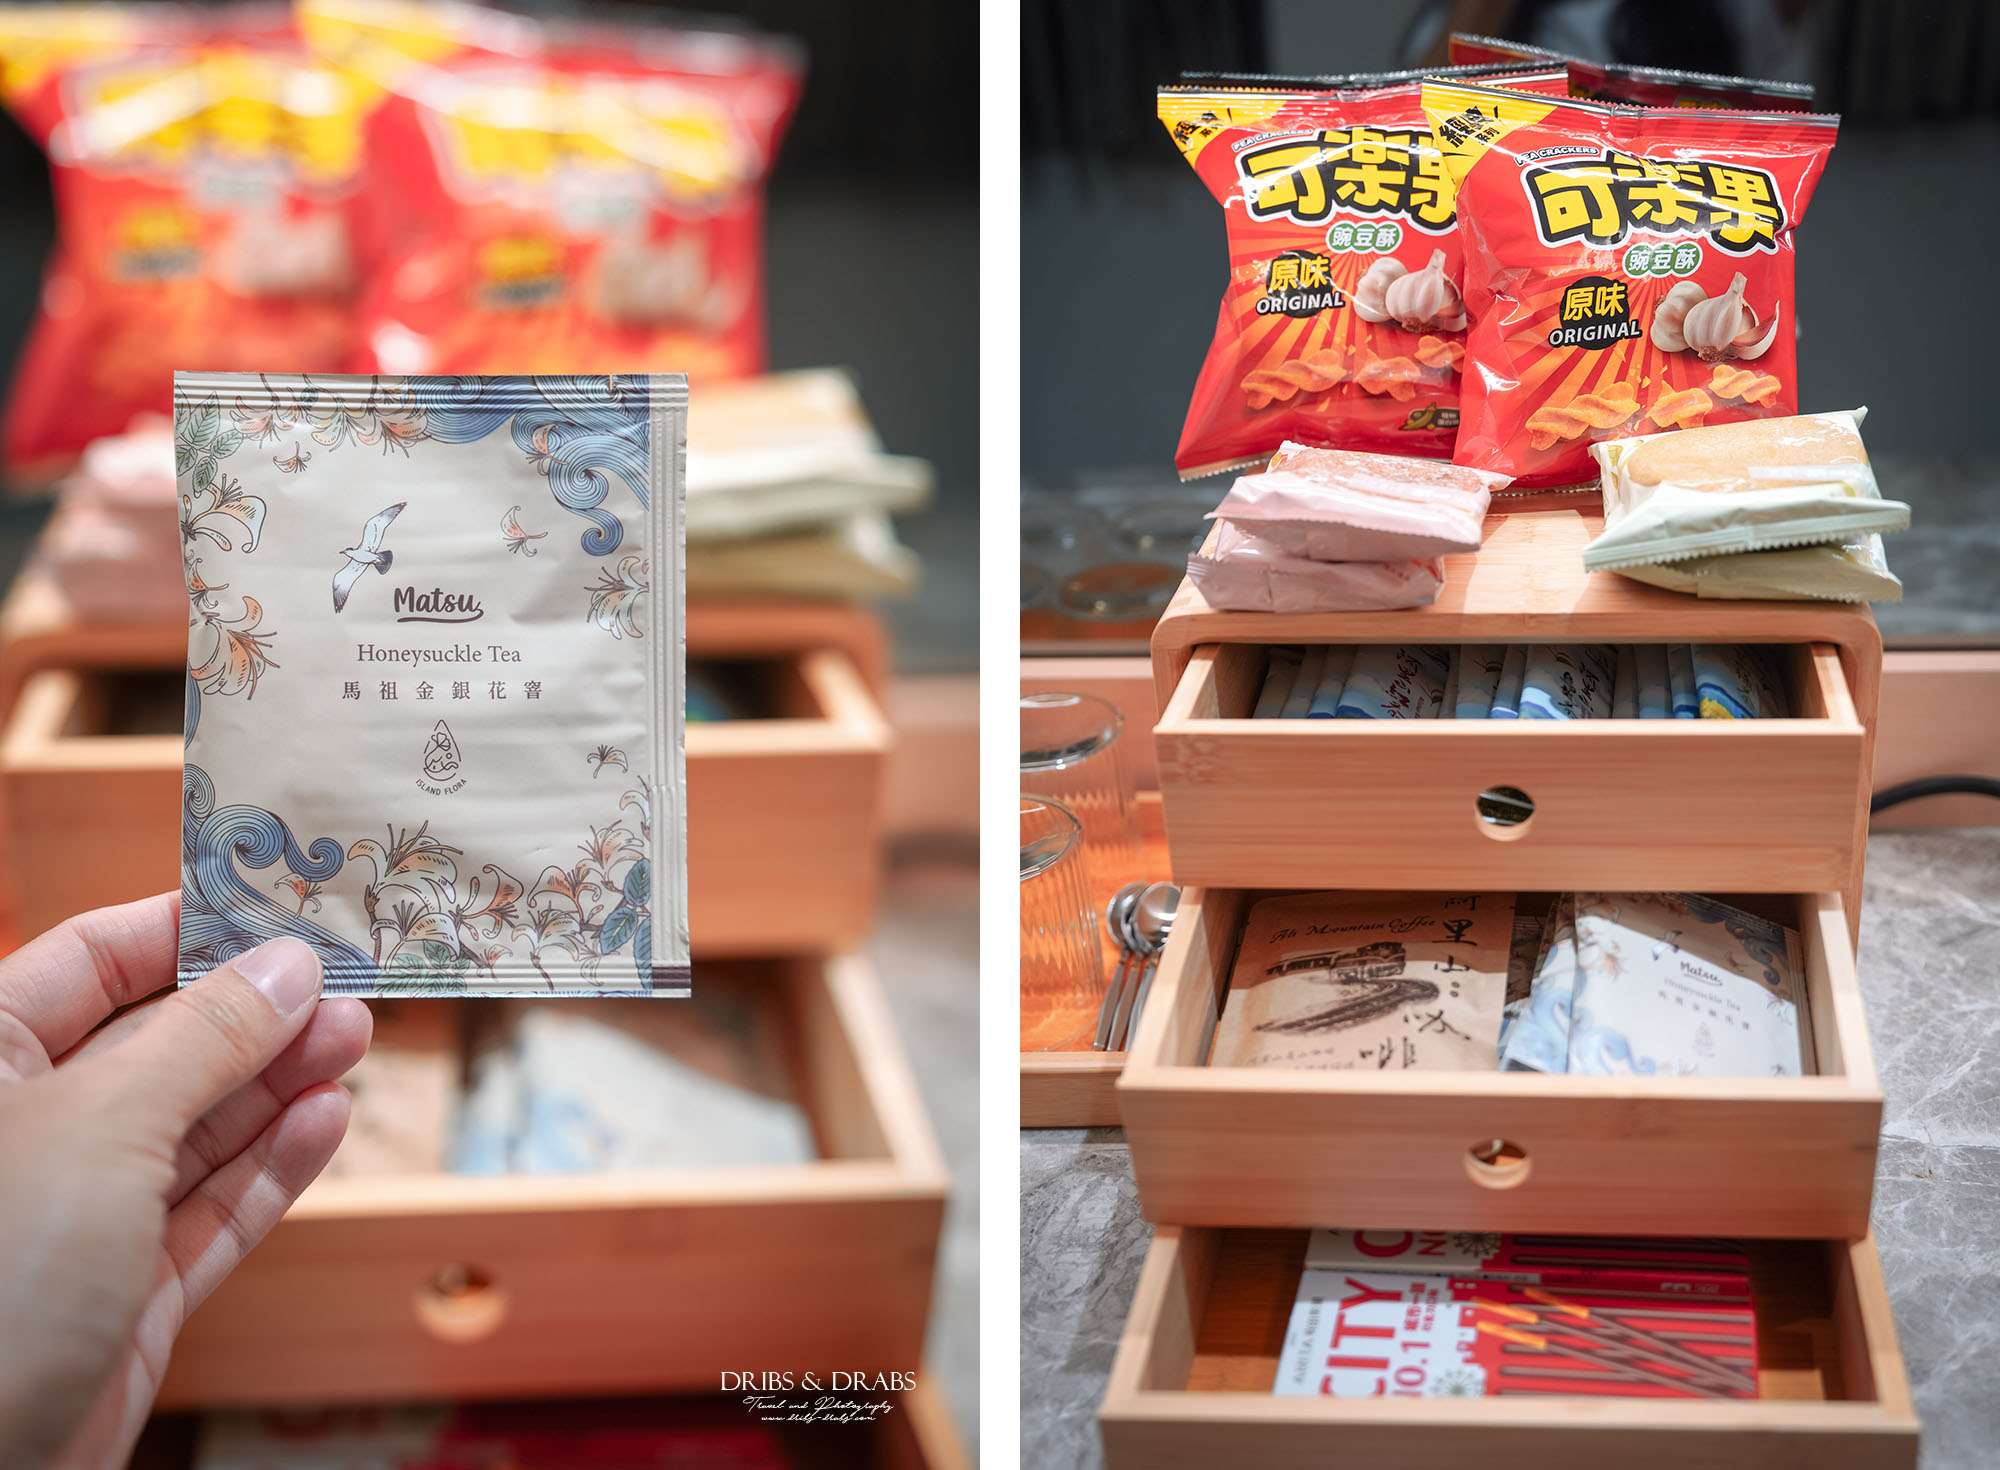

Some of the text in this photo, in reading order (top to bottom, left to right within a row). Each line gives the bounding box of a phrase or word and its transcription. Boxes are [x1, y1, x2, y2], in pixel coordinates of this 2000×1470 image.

[1540, 146, 1598, 159] CRACKERS
[1331, 226, 1397, 248] 豌豆酥
[1627, 247, 1697, 273] 豌豆酥
[1269, 255, 1330, 291] 原味
[1258, 292, 1344, 315] ORIGINAL
[1562, 282, 1626, 321] 原味
[1549, 320, 1640, 346] ORIGINAL
[393, 586, 485, 624] Matsu
[357, 643, 522, 668] Honeysuckle Tea
[415, 777, 468, 797] ISLAND FLORA
[1305, 921, 1385, 937] Mountain
[1388, 914, 1437, 935] Coffee
[1679, 961, 1724, 986] Matsu
